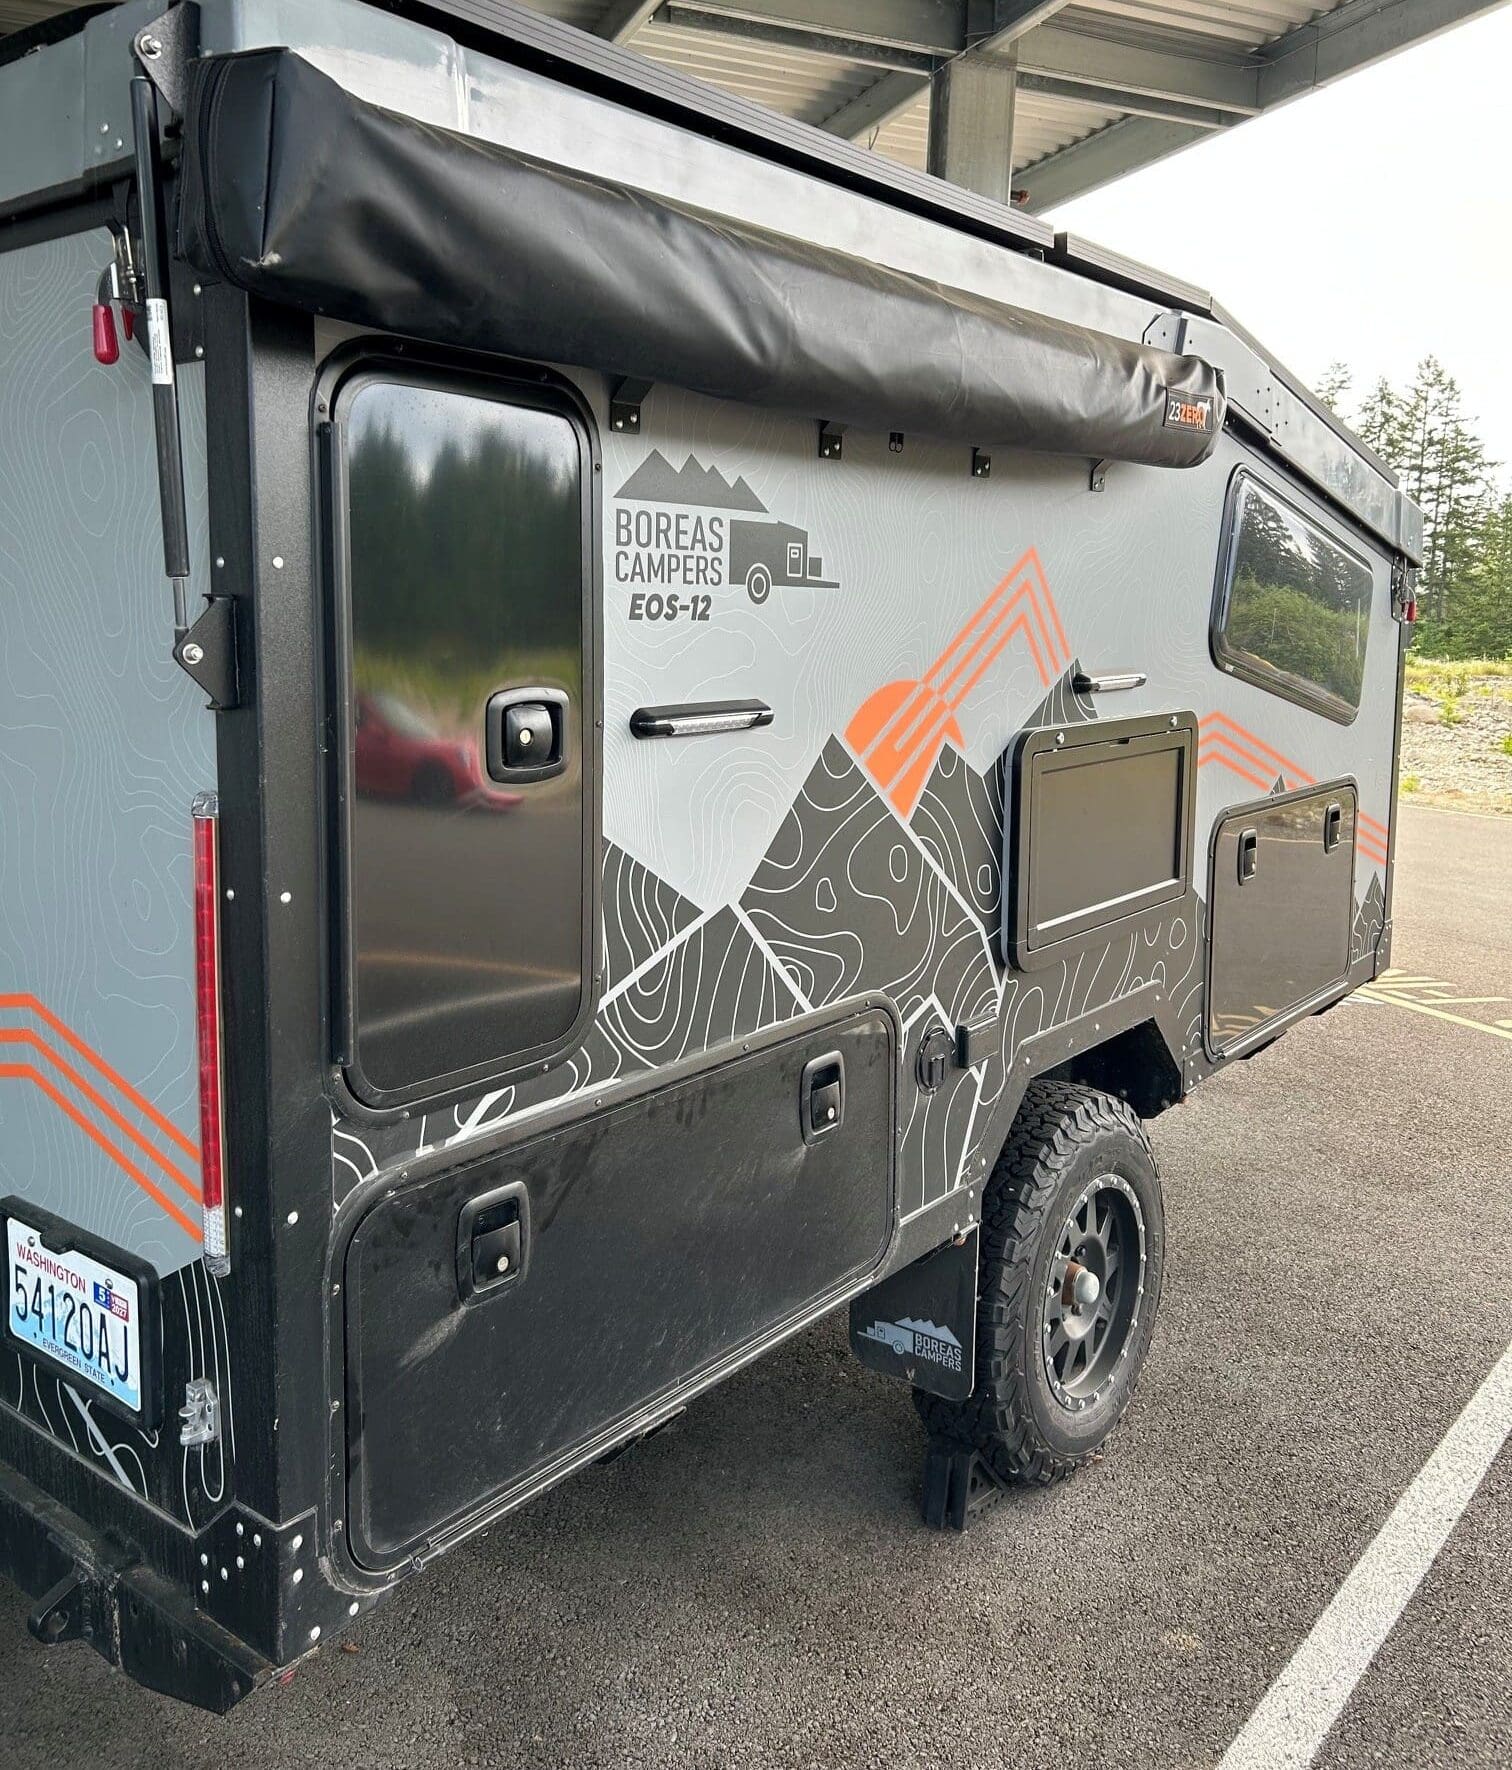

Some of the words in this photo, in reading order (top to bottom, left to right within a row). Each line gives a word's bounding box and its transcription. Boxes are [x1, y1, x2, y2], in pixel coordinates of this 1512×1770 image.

[615, 508, 724, 552] BOREAS
[615, 551, 723, 586] CAMPERS
[629, 593, 712, 621] EOS-12
[16, 1242, 87, 1294] WASHINGTON
[98, 1287, 106, 1302] 5
[15, 1264, 129, 1383] 54120AJ
[43, 1338, 82, 1369] EVERGREEN
[84, 1362, 106, 1384] STATE
[914, 1333, 962, 1361] BOREAS
[914, 1345, 962, 1372] CAMPERS
